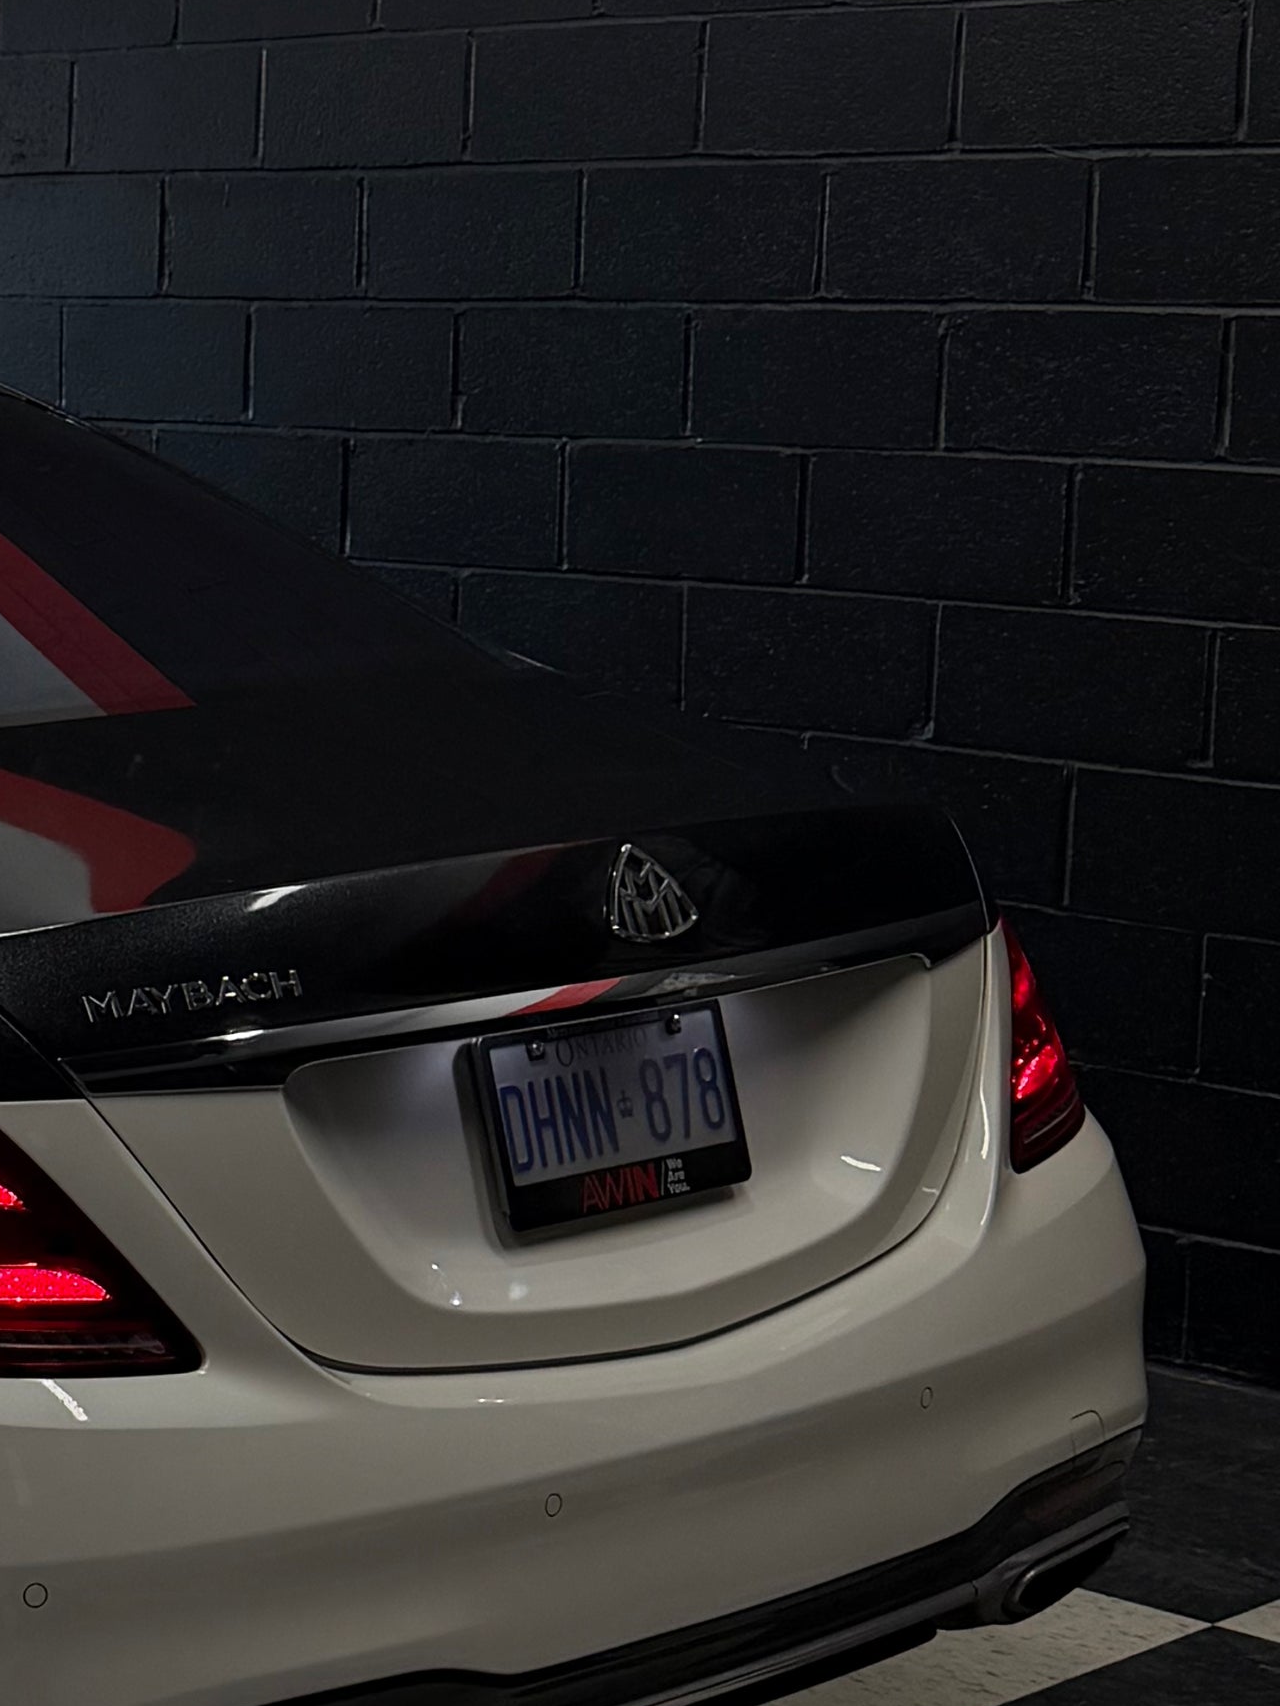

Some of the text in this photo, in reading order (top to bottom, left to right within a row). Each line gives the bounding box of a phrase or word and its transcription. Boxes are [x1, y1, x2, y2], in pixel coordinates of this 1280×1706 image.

[82, 969, 303, 1023] MAYBACH
[555, 1027, 648, 1067] ONTARIO
[500, 1047, 726, 1174] DHNN 878
[666, 1157, 683, 1170] We
[667, 1170, 686, 1183] Are
[581, 1162, 660, 1214] AWIN
